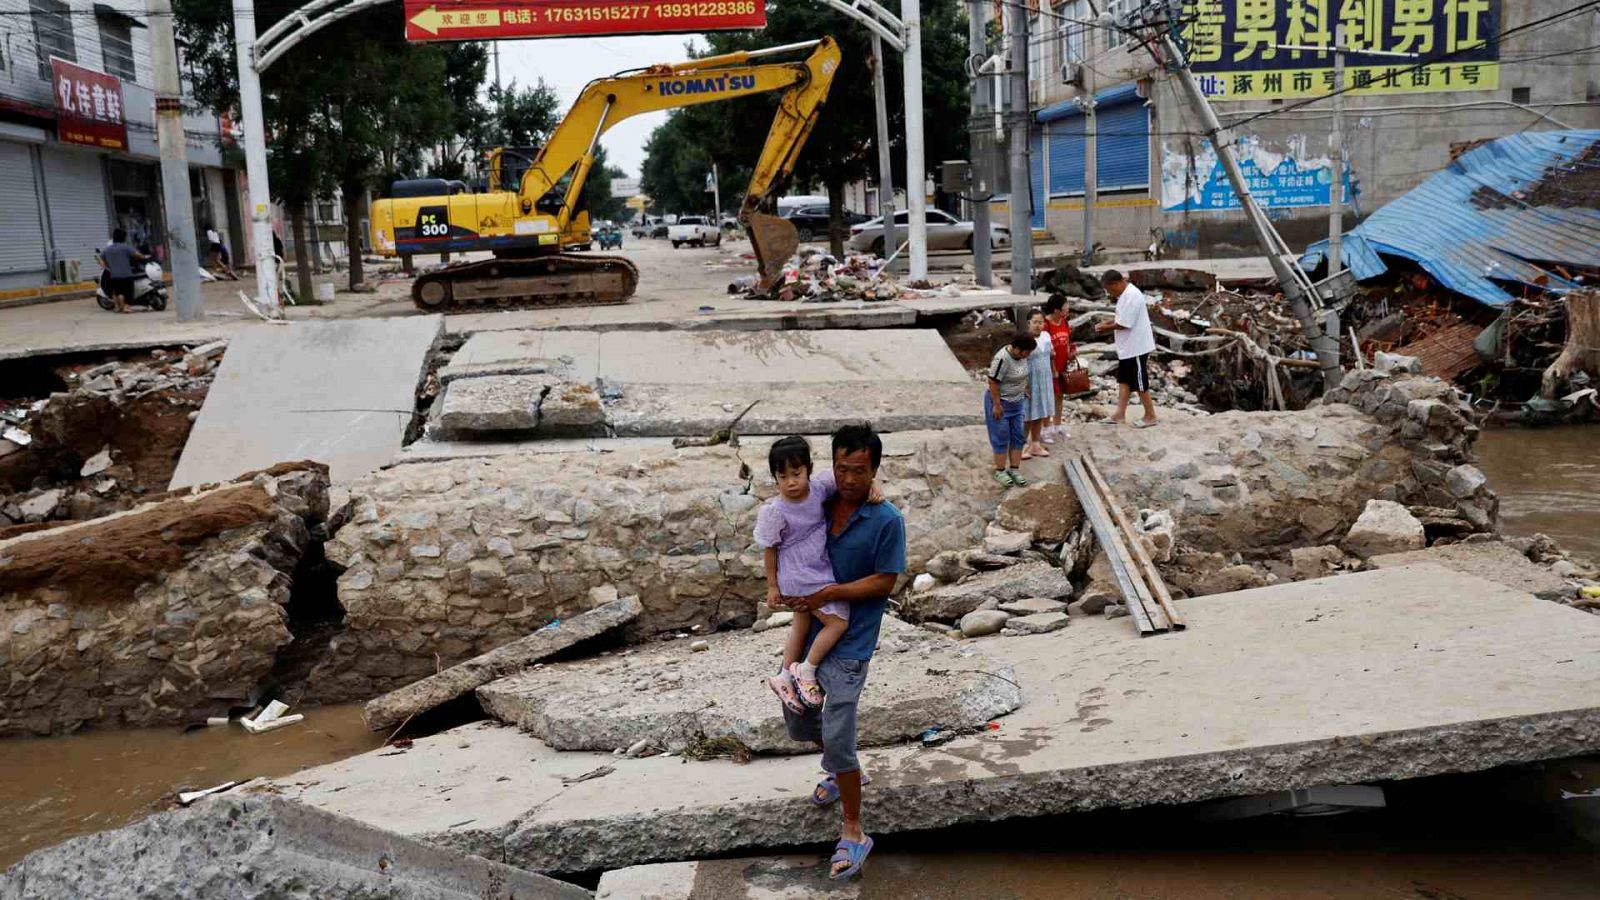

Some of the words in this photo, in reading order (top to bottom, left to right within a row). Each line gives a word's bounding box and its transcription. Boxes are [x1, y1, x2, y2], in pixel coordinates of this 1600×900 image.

[441, 13, 488, 25] 欢迎您
[544, 5, 649, 22] 17631515277
[655, 1, 755, 18] 13931228386
[659, 73, 756, 96] KOMATSU
[58, 76, 120, 123] 忆佳童鞋
[421, 214, 436, 224] PC
[422, 224, 448, 236] 300
